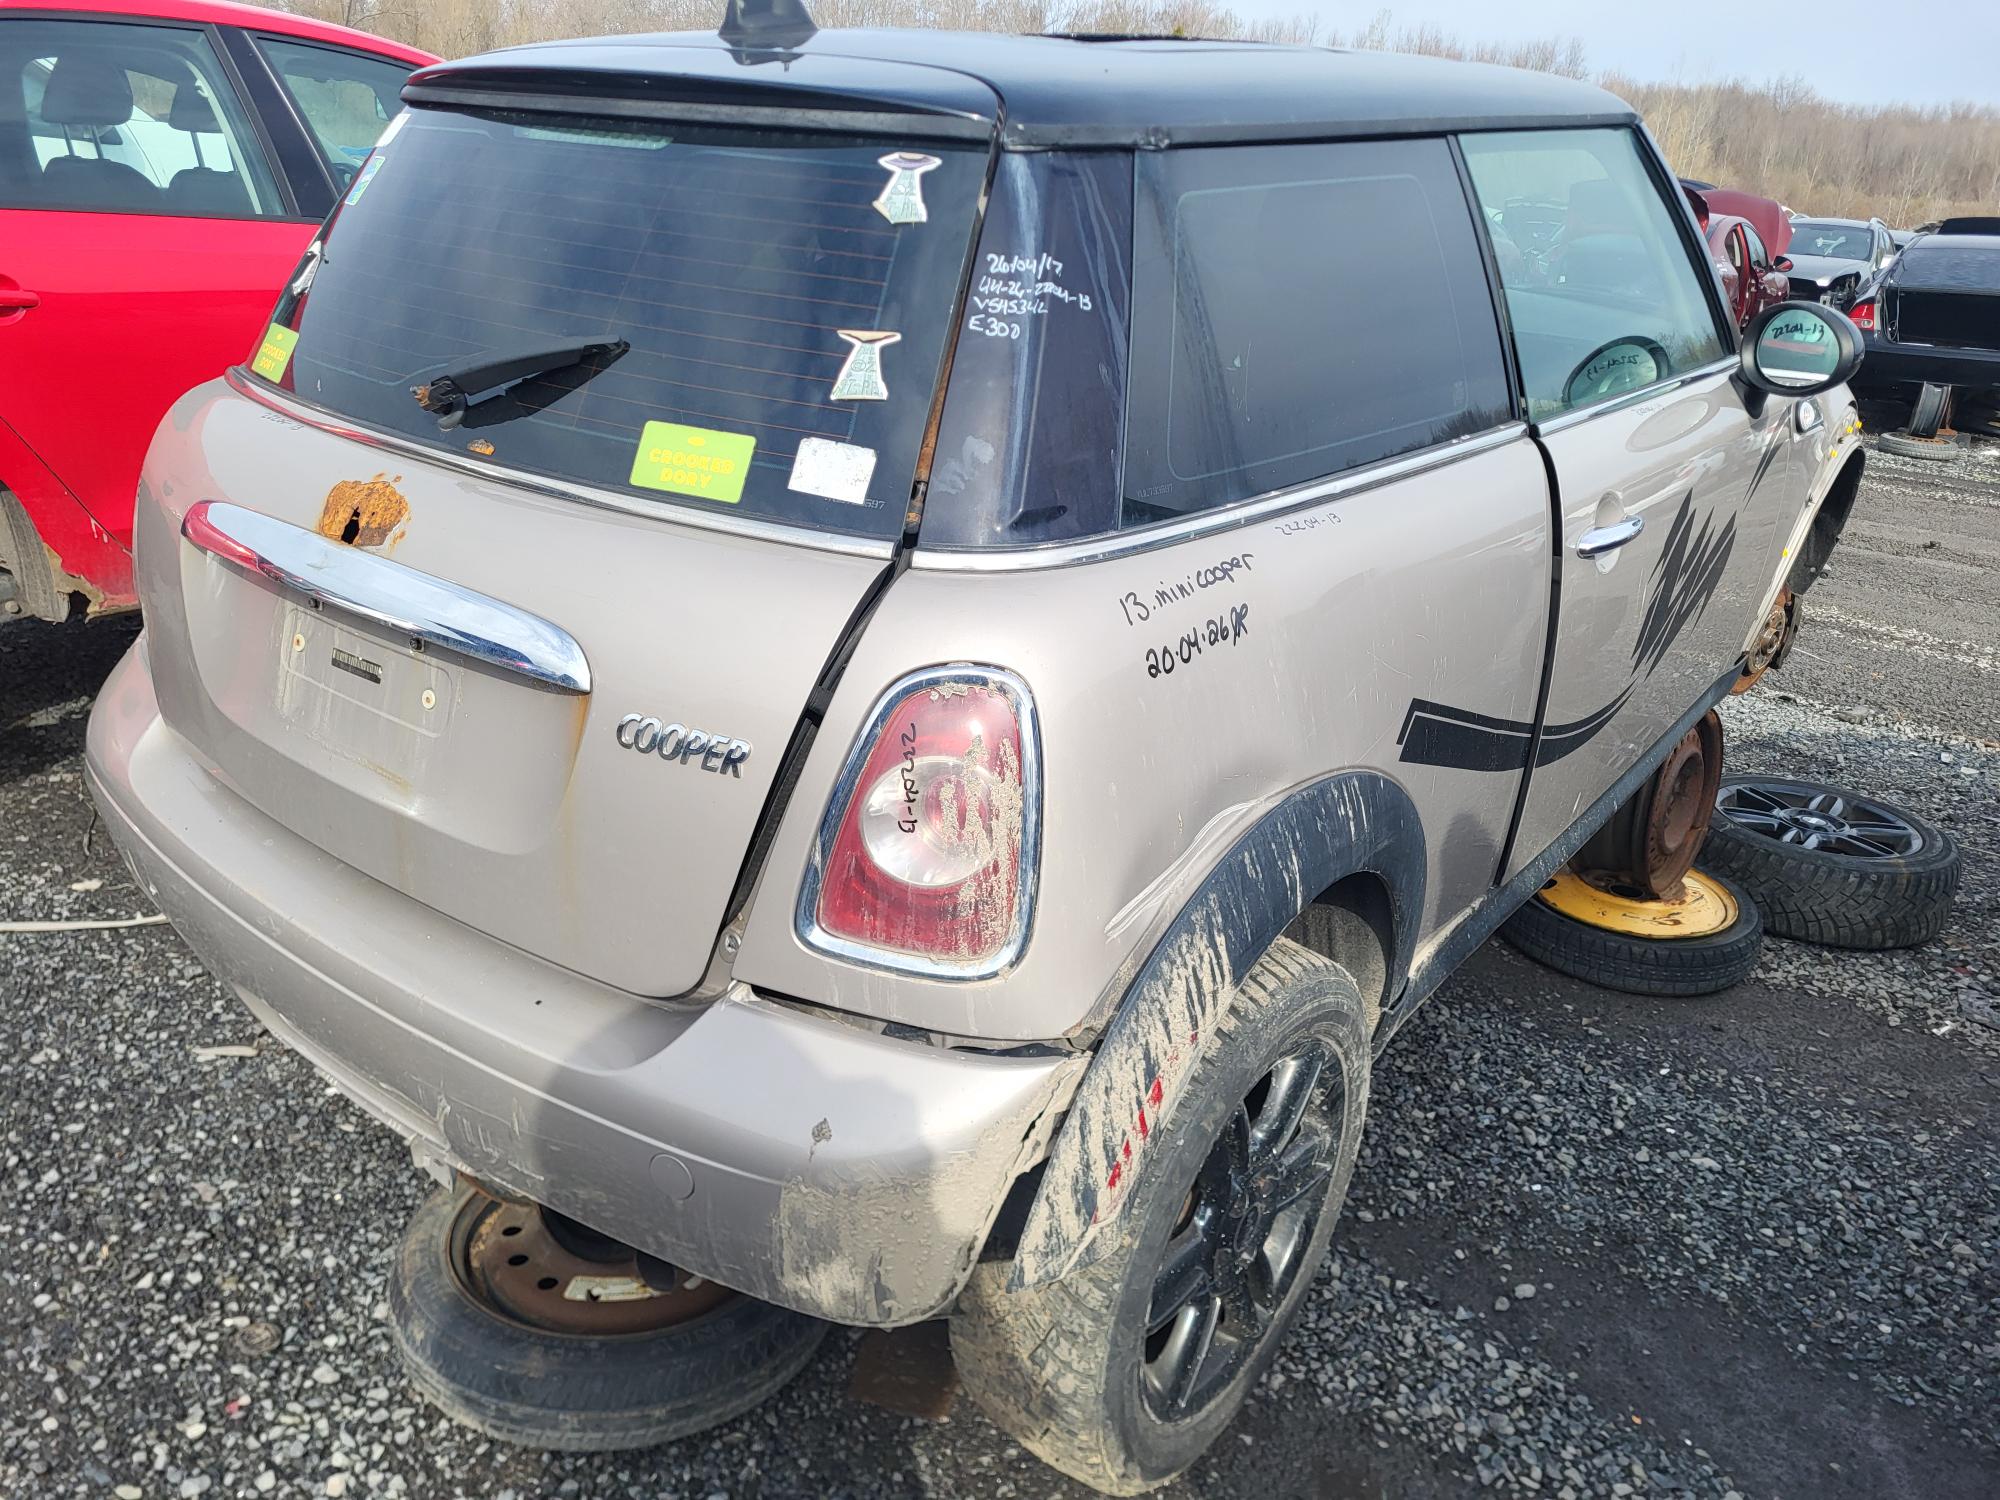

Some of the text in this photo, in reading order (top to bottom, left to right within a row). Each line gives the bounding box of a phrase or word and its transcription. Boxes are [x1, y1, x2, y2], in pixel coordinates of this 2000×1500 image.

[648, 447, 736, 475] CROOKED
[660, 466, 713, 489] DORY
[1274, 512, 1342, 536] 22204-13
[615, 711, 754, 780] COOPER
